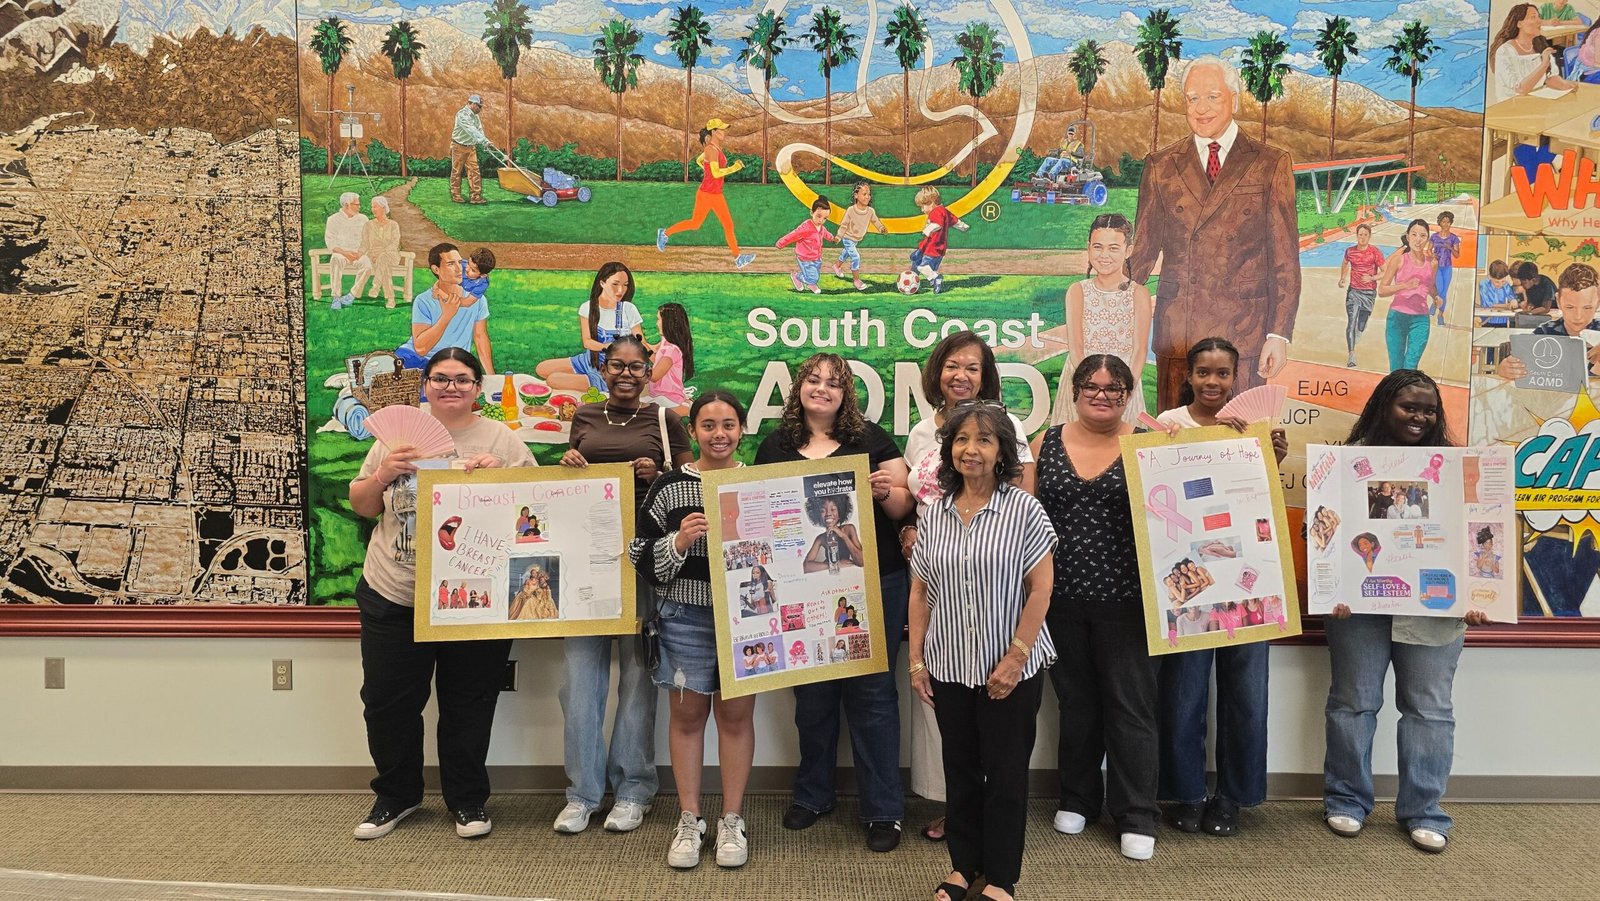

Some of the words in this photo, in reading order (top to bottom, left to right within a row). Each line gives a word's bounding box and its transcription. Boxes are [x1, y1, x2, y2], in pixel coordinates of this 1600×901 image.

[1548, 217, 1578, 230] Why
[746, 307, 886, 349] South
[1298, 380, 1348, 396] EJAG
[1528, 377, 1564, 387] AQMD
[1279, 408, 1320, 424] JCP
[1150, 451, 1161, 468] A
[1167, 446, 1213, 465] Journey
[1220, 448, 1234, 460] of
[1238, 444, 1260, 460] Hope
[813, 480, 838, 489] elevate
[838, 478, 852, 487] how
[813, 487, 827, 496] you
[827, 485, 853, 495] hydrate
[458, 484, 517, 511] Breast
[1532, 494, 1547, 502] AIR
[1548, 494, 1584, 503] PROGRAM
[463, 526, 472, 541] I
[474, 527, 504, 551] HAVE
[456, 543, 497, 566] BREAST
[448, 556, 488, 577] CANCER
